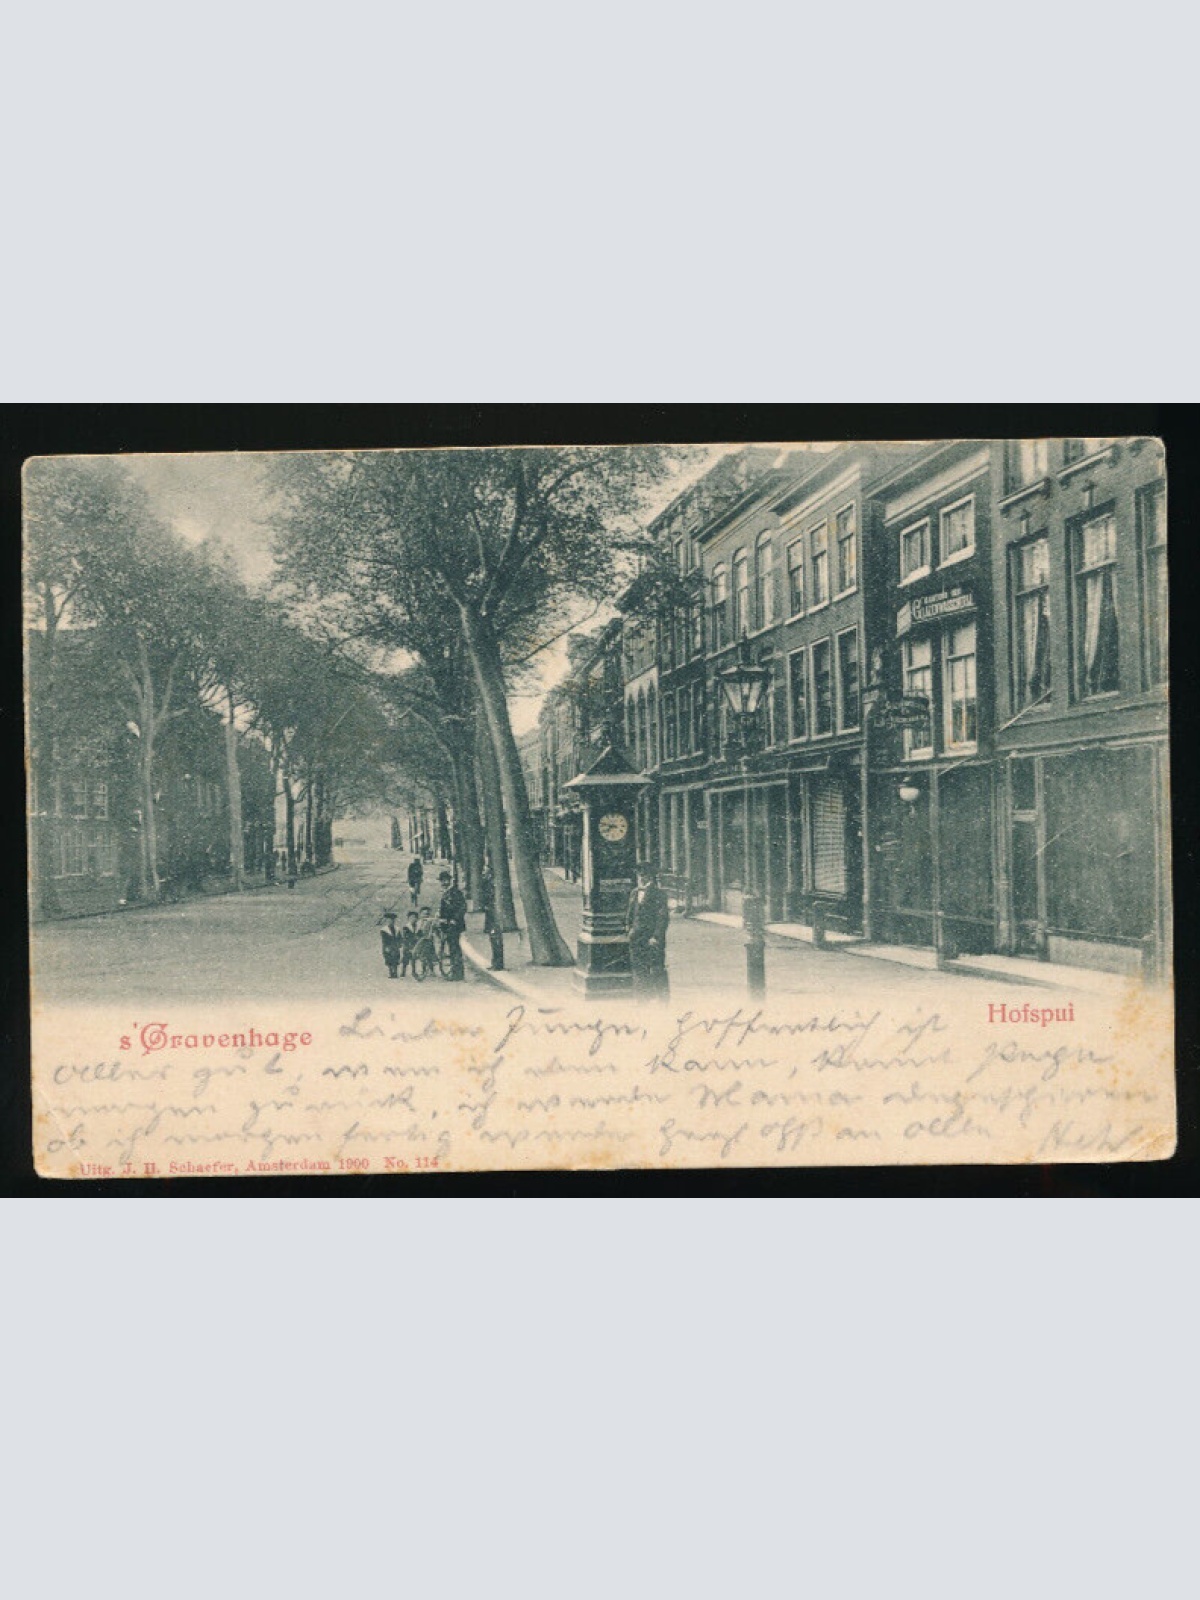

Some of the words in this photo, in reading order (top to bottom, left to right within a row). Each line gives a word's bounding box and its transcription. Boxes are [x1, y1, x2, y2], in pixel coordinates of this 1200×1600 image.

[987, 1003, 1075, 1027] Hofspui
[897, 1006, 951, 1054] ist
[80, 1163, 115, 1177] Uitg.
[245, 1157, 331, 1173] Amsterdam
[338, 1157, 370, 1171] 1900
[384, 1156, 410, 1171] No.
